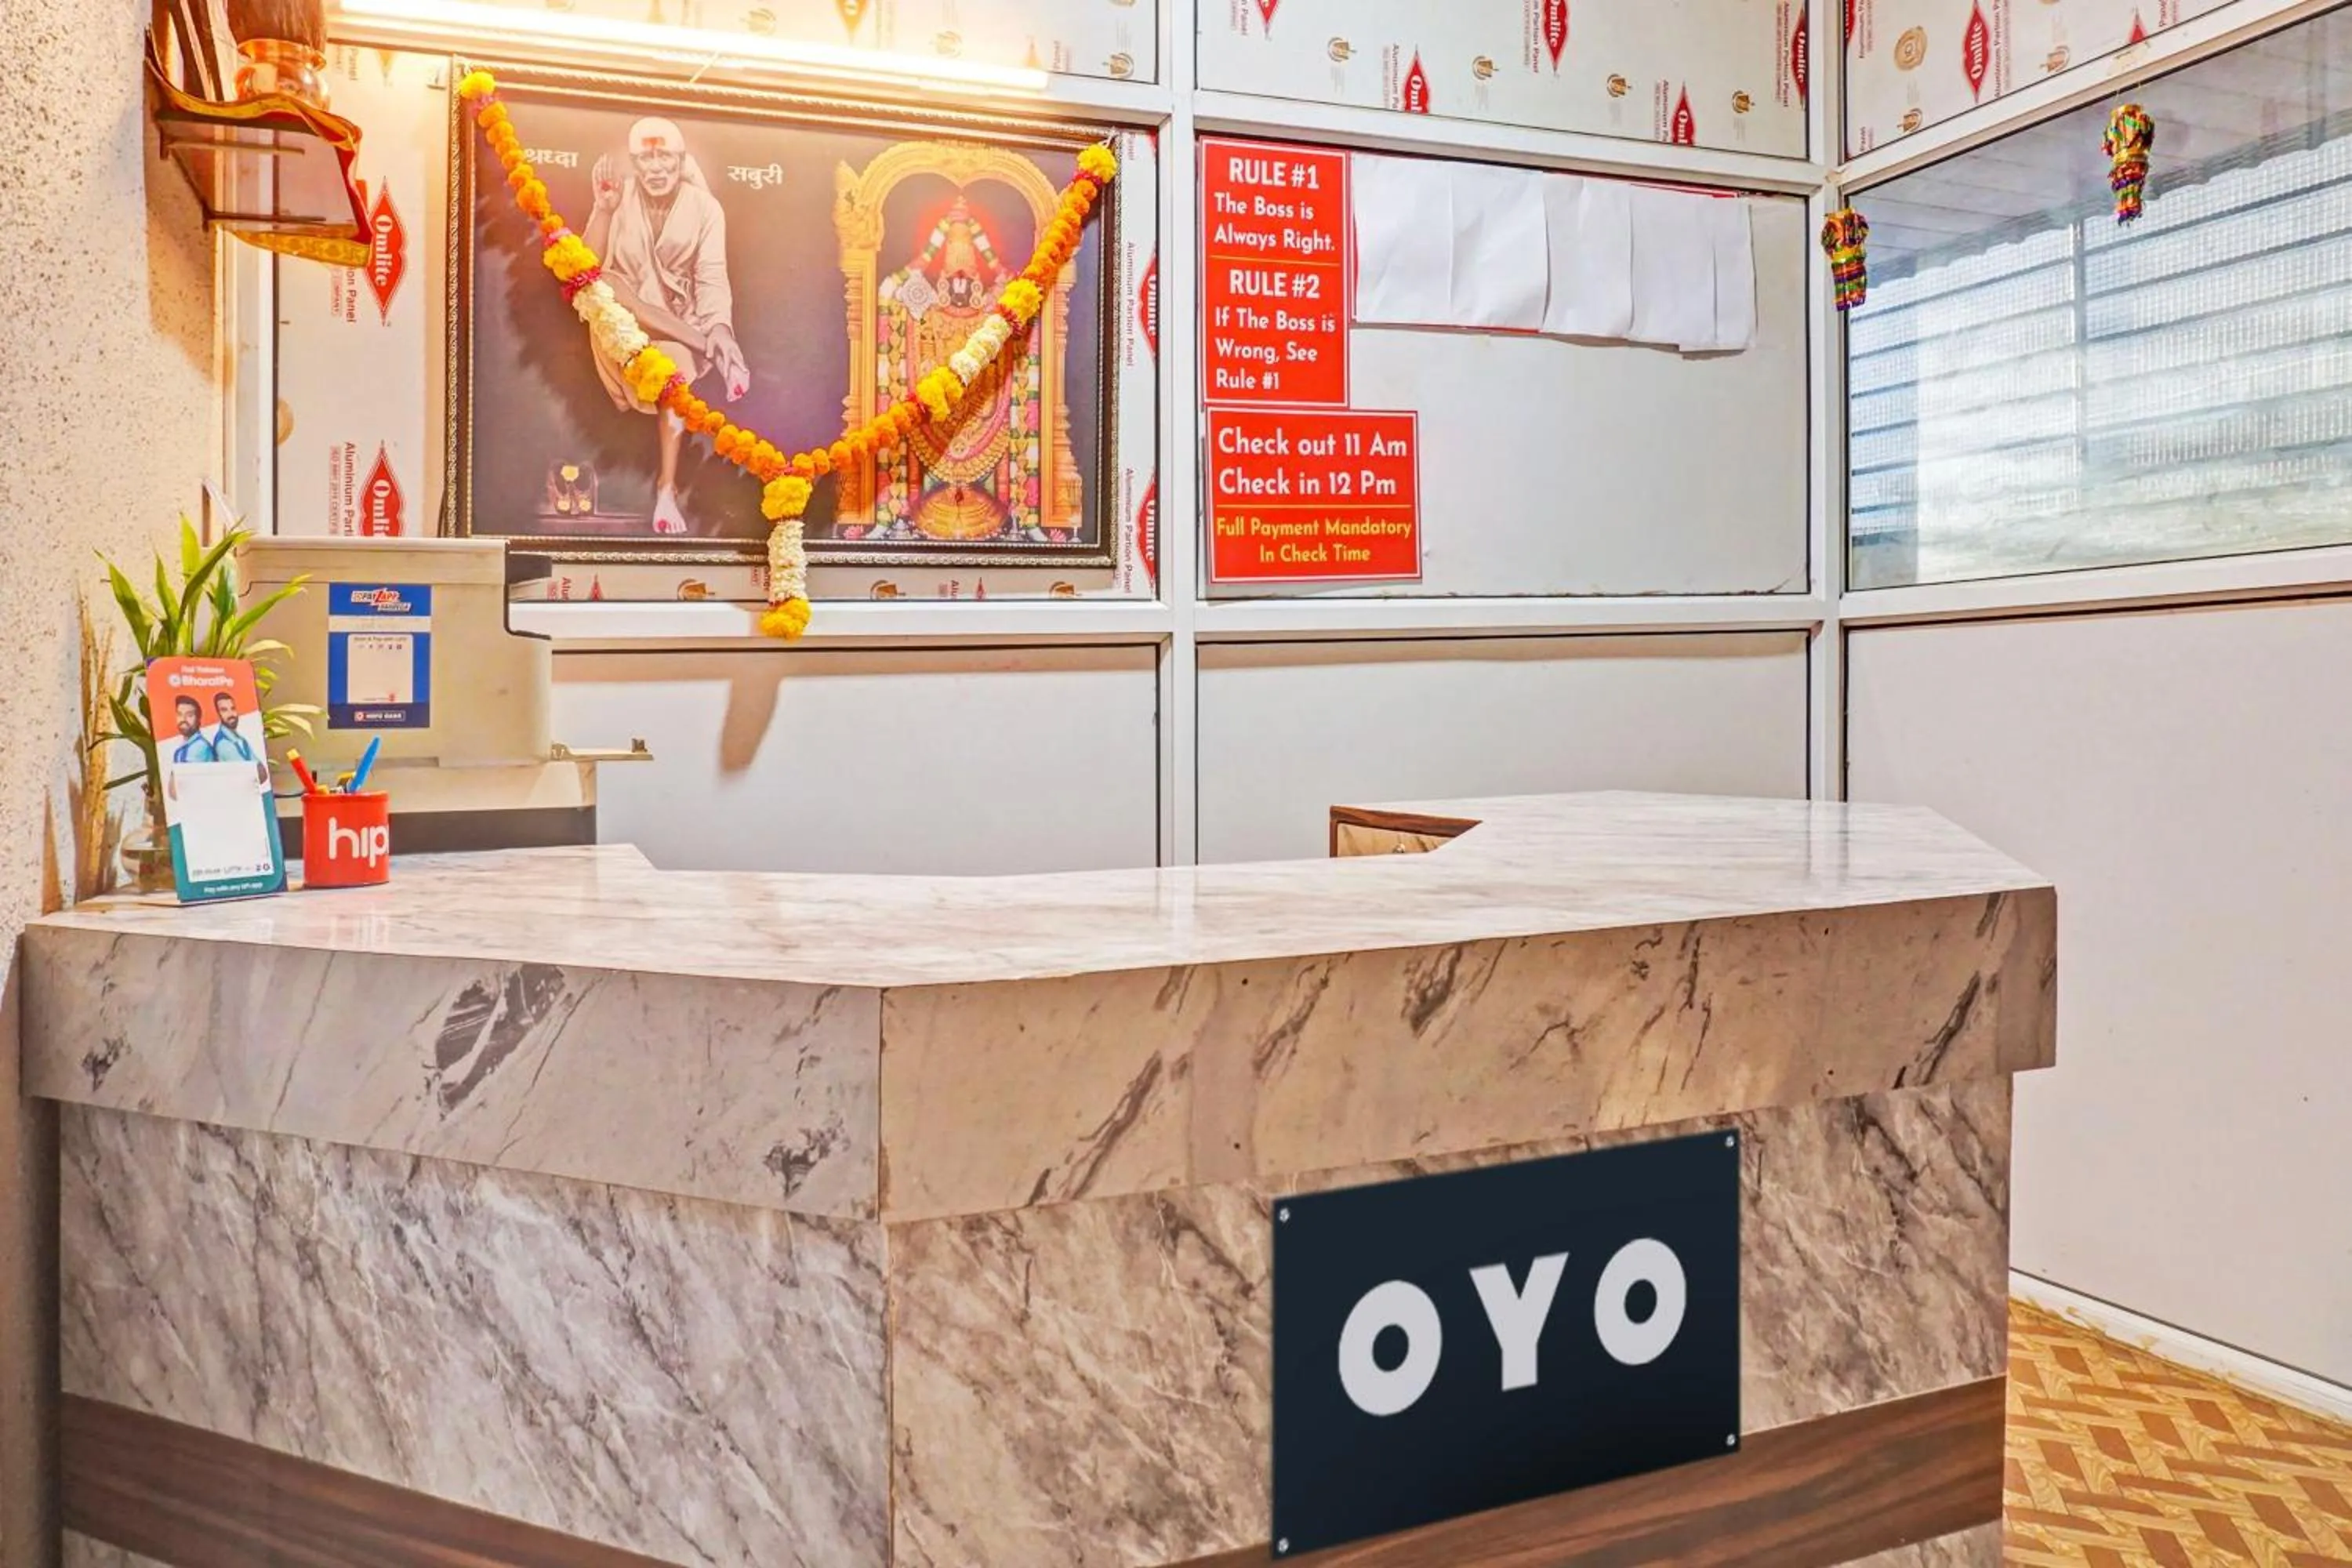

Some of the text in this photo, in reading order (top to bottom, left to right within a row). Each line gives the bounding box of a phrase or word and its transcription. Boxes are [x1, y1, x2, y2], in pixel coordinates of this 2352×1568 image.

[1969, 21, 1984, 80] Omlite
[1410, 74, 1423, 111] Oml
[1679, 110, 1689, 143] Oml
[727, 162, 783, 190] सबुरी
[1229, 156, 1319, 190] RULE #1
[1214, 191, 1315, 220] The Boss is
[374, 214, 393, 287] Omlite
[1214, 222, 1335, 255] Always Right.
[1229, 268, 1321, 299] RULE #2
[347, 289, 358, 323] Panel
[1215, 306, 1336, 333] If The Boss is
[1215, 337, 1319, 365] Wrong, See
[1215, 367, 1280, 390] Rule #1
[1218, 426, 1408, 457] Check out 11 Am
[344, 441, 355, 537] Aluminium Parti
[1219, 466, 1397, 495] Check in 12 Pm
[372, 479, 391, 537] Omlit
[1217, 515, 1413, 540] Full Payment Mandatory
[1259, 543, 1371, 563] In Check Time
[1338, 1237, 1687, 1417] OYO
